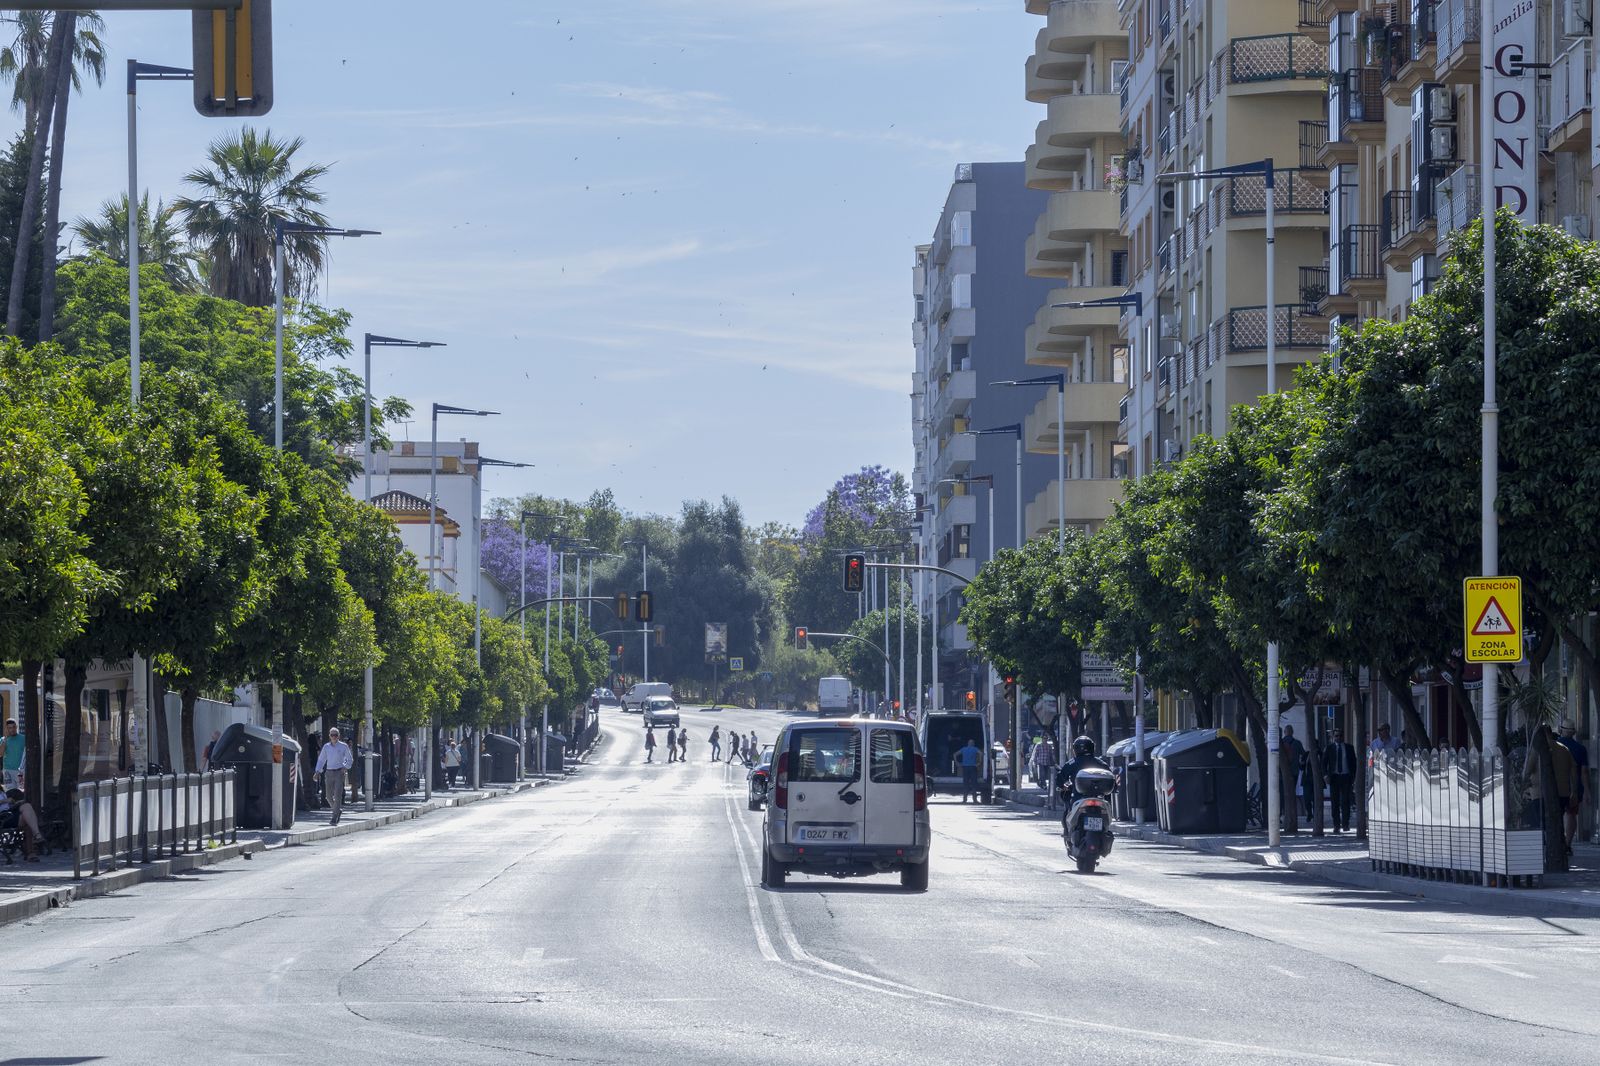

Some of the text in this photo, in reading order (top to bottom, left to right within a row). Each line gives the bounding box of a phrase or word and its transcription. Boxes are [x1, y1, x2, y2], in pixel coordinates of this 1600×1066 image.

[1493, 0, 1533, 35] amilia
[1469, 581, 1516, 591] ATENCIÓN
[1480, 641, 1506, 649] ZONA
[1472, 649, 1515, 657] ESCOLAR
[806, 830, 827, 839] 0247
